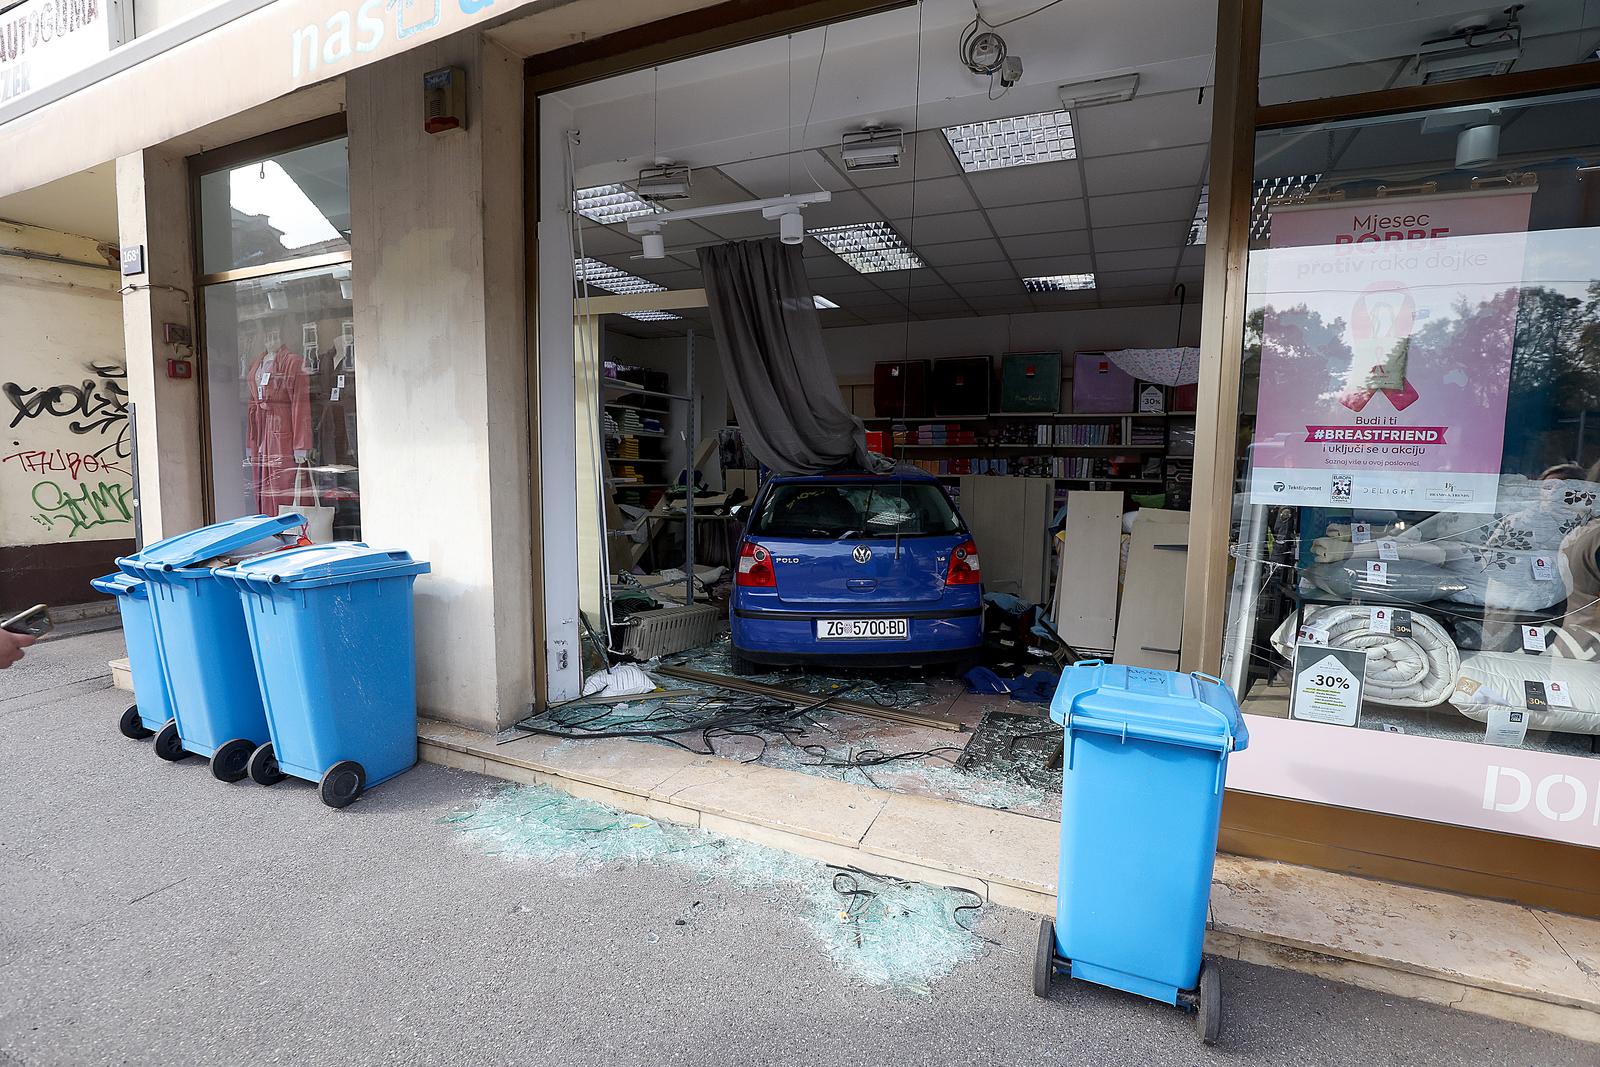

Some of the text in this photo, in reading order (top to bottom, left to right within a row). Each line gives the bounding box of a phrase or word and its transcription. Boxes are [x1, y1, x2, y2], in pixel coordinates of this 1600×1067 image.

[1353, 212, 1431, 234] Mjesec
[1296, 250, 1488, 279] protiv raka dojke
[1355, 416, 1380, 425] Budi
[1389, 416, 1398, 425] ti
[1314, 429, 1438, 441] #BREASTFRIEND
[1328, 444, 1364, 455] uključi
[1366, 445, 1379, 454] se
[1381, 446, 1389, 454] u
[1391, 445, 1426, 456] akciju
[775, 556, 800, 564] POLO
[826, 620, 844, 636] ZG
[1309, 674, 1350, 690] -30%
[1482, 765, 1600, 827] DO
